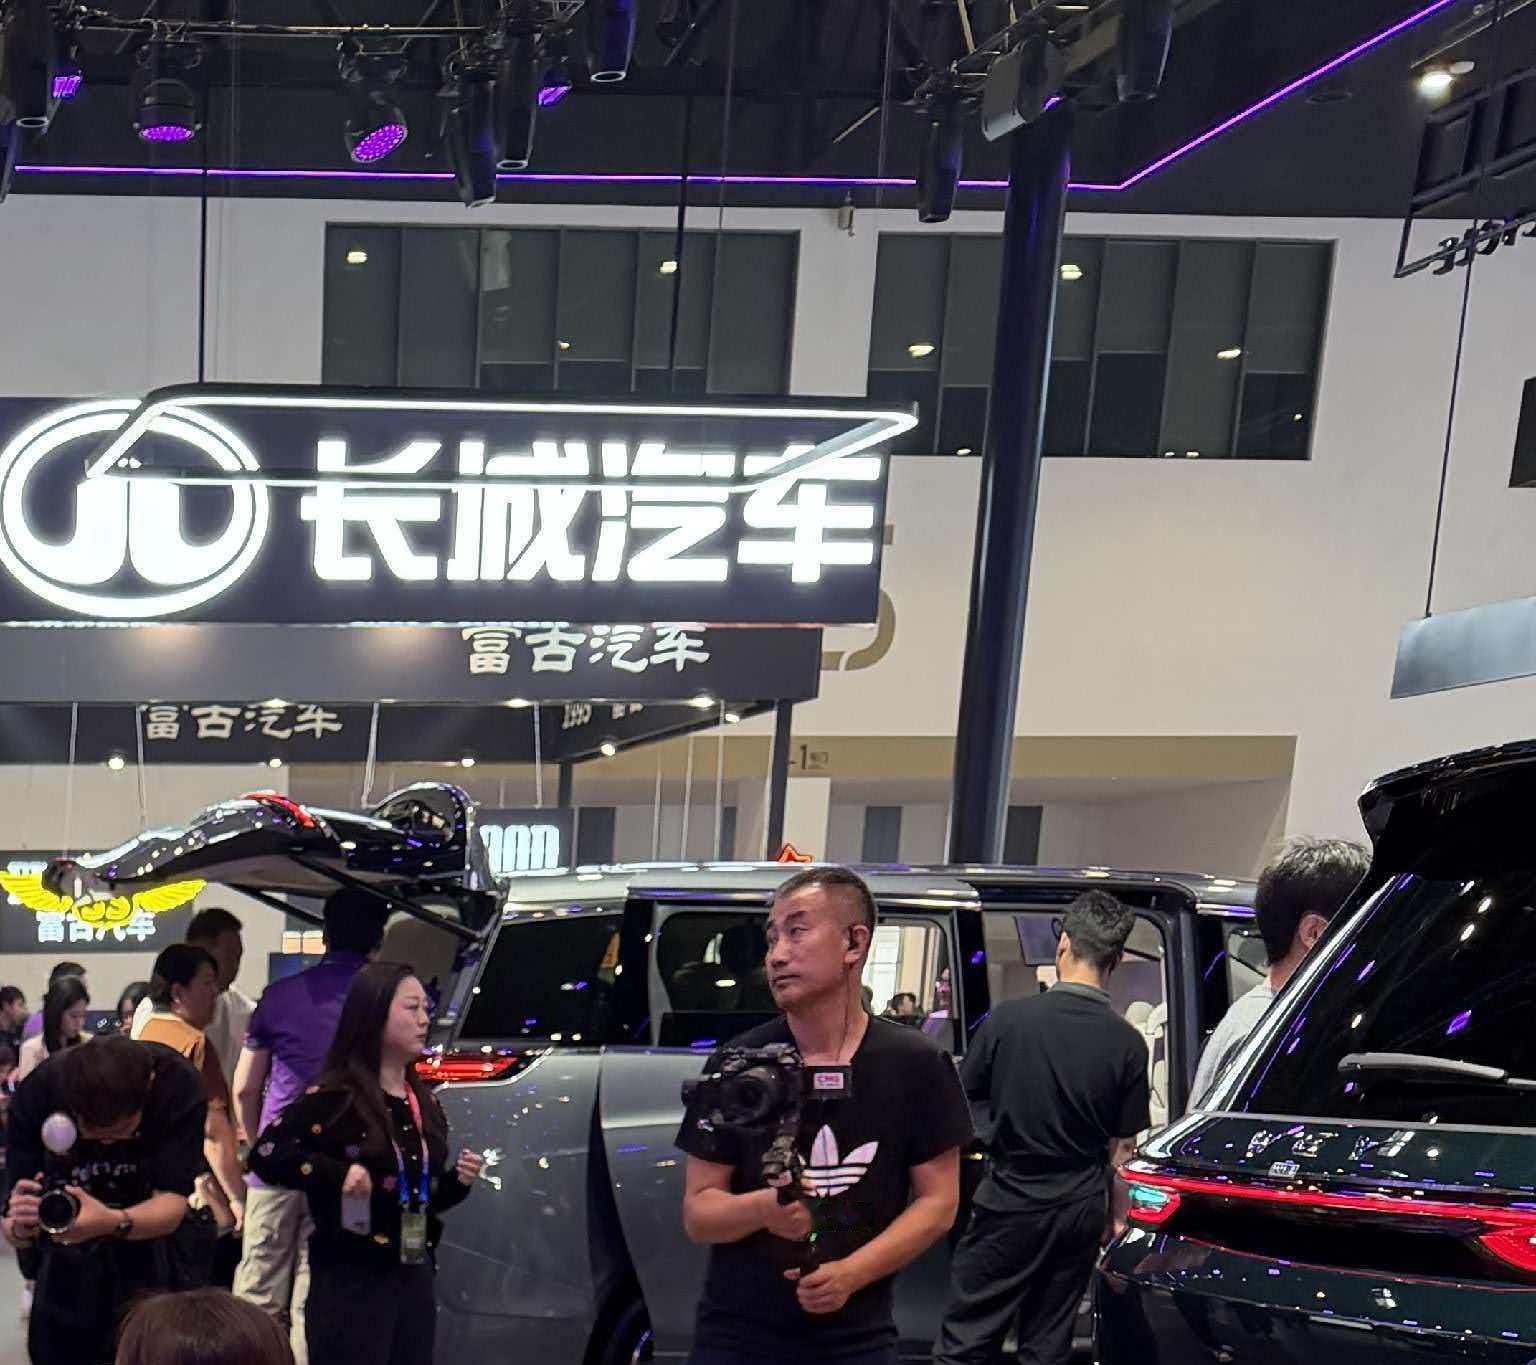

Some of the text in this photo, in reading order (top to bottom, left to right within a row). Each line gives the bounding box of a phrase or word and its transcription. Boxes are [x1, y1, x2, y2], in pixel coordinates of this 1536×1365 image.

[301, 440, 882, 583] 长城汽车
[462, 623, 710, 674] 富古汽车
[139, 702, 343, 740] 富古汽车
